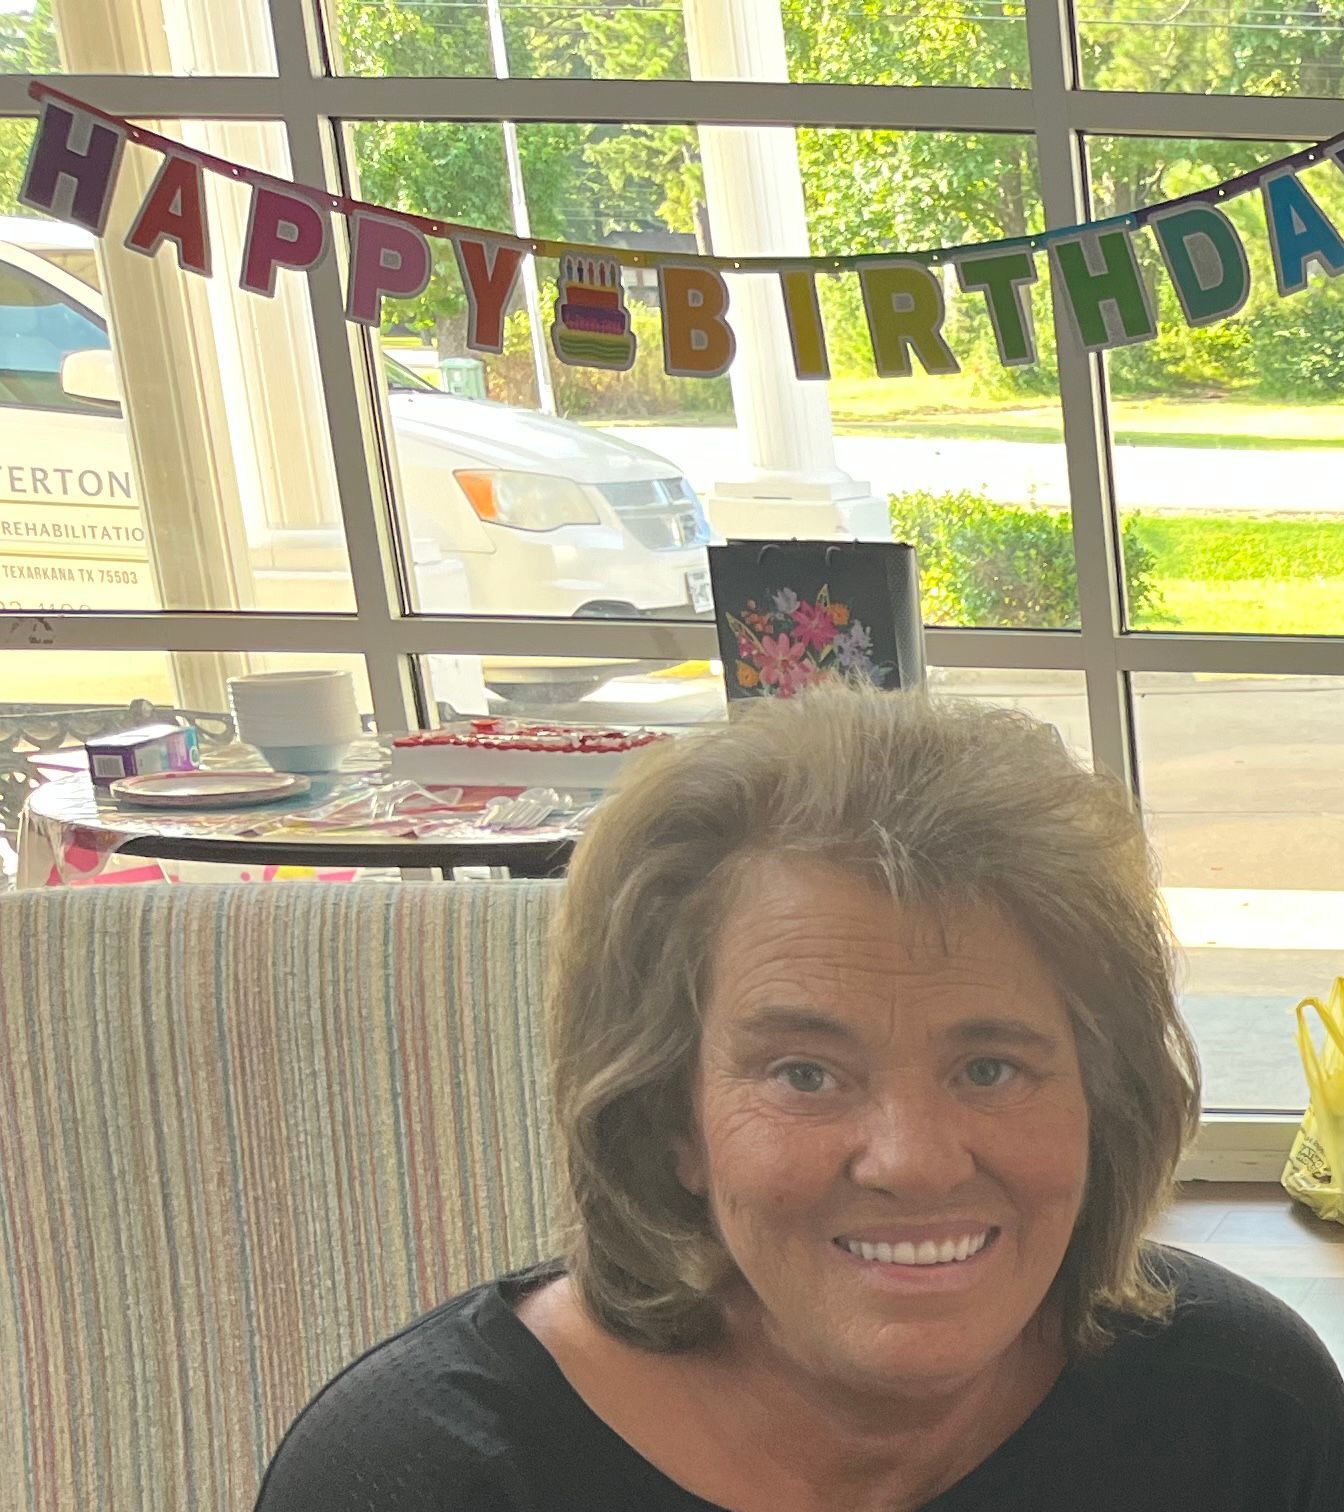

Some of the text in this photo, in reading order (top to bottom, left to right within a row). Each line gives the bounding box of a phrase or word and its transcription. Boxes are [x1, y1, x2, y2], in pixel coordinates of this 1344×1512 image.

[20, 100, 528, 354] HAPPY
[0, 465, 131, 499] ERTON
[1, 521, 145, 542] REHABILITATIO
[2, 565, 138, 585] TEXARKANA TX 75503
